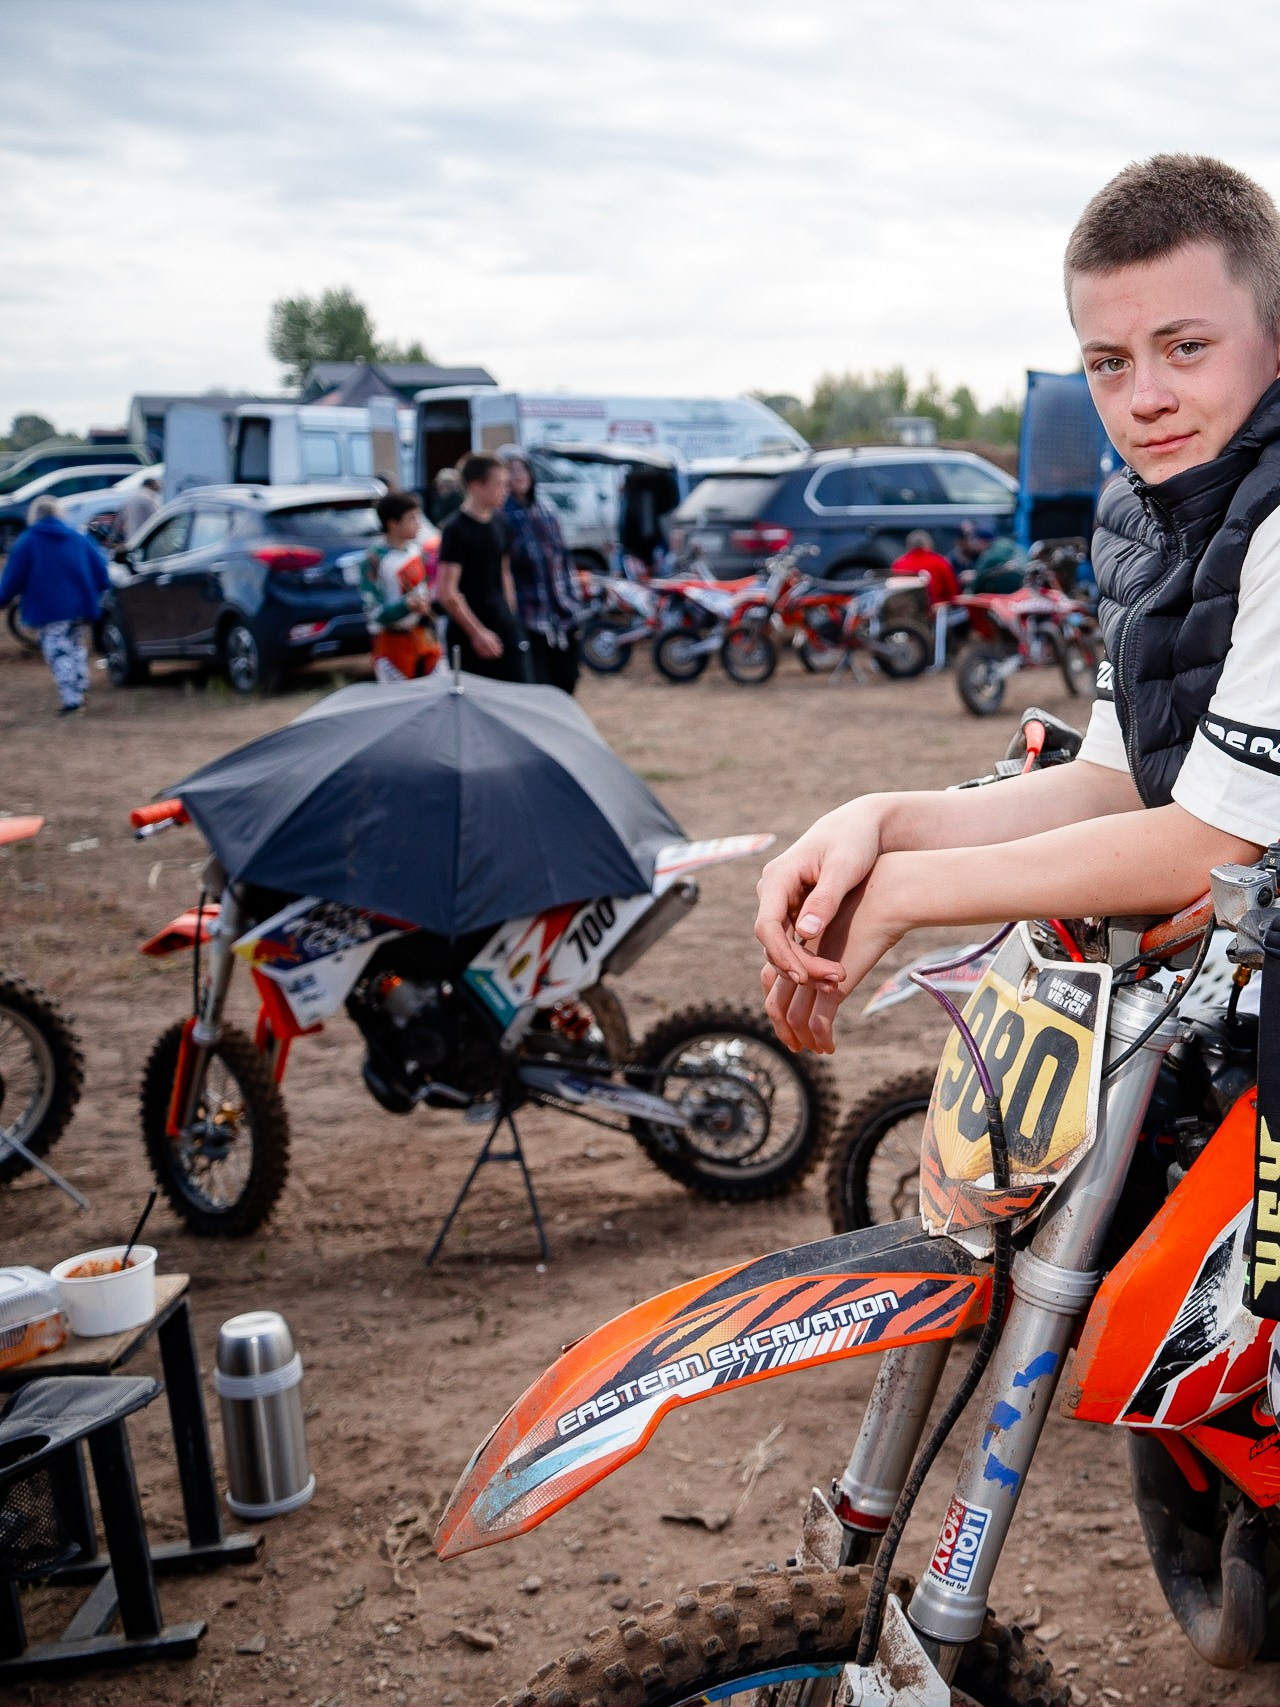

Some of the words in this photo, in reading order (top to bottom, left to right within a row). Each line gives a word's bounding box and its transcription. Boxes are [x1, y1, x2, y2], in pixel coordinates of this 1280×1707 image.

[566, 896, 617, 964] 700
[940, 986, 1080, 1167] 980
[556, 1354, 706, 1437] EASTERN
[707, 1291, 900, 1371] EXCAVATION
[934, 1502, 964, 1576] MOLY
[948, 1511, 986, 1580] LIQUI
[956, 1581, 967, 1592] by
